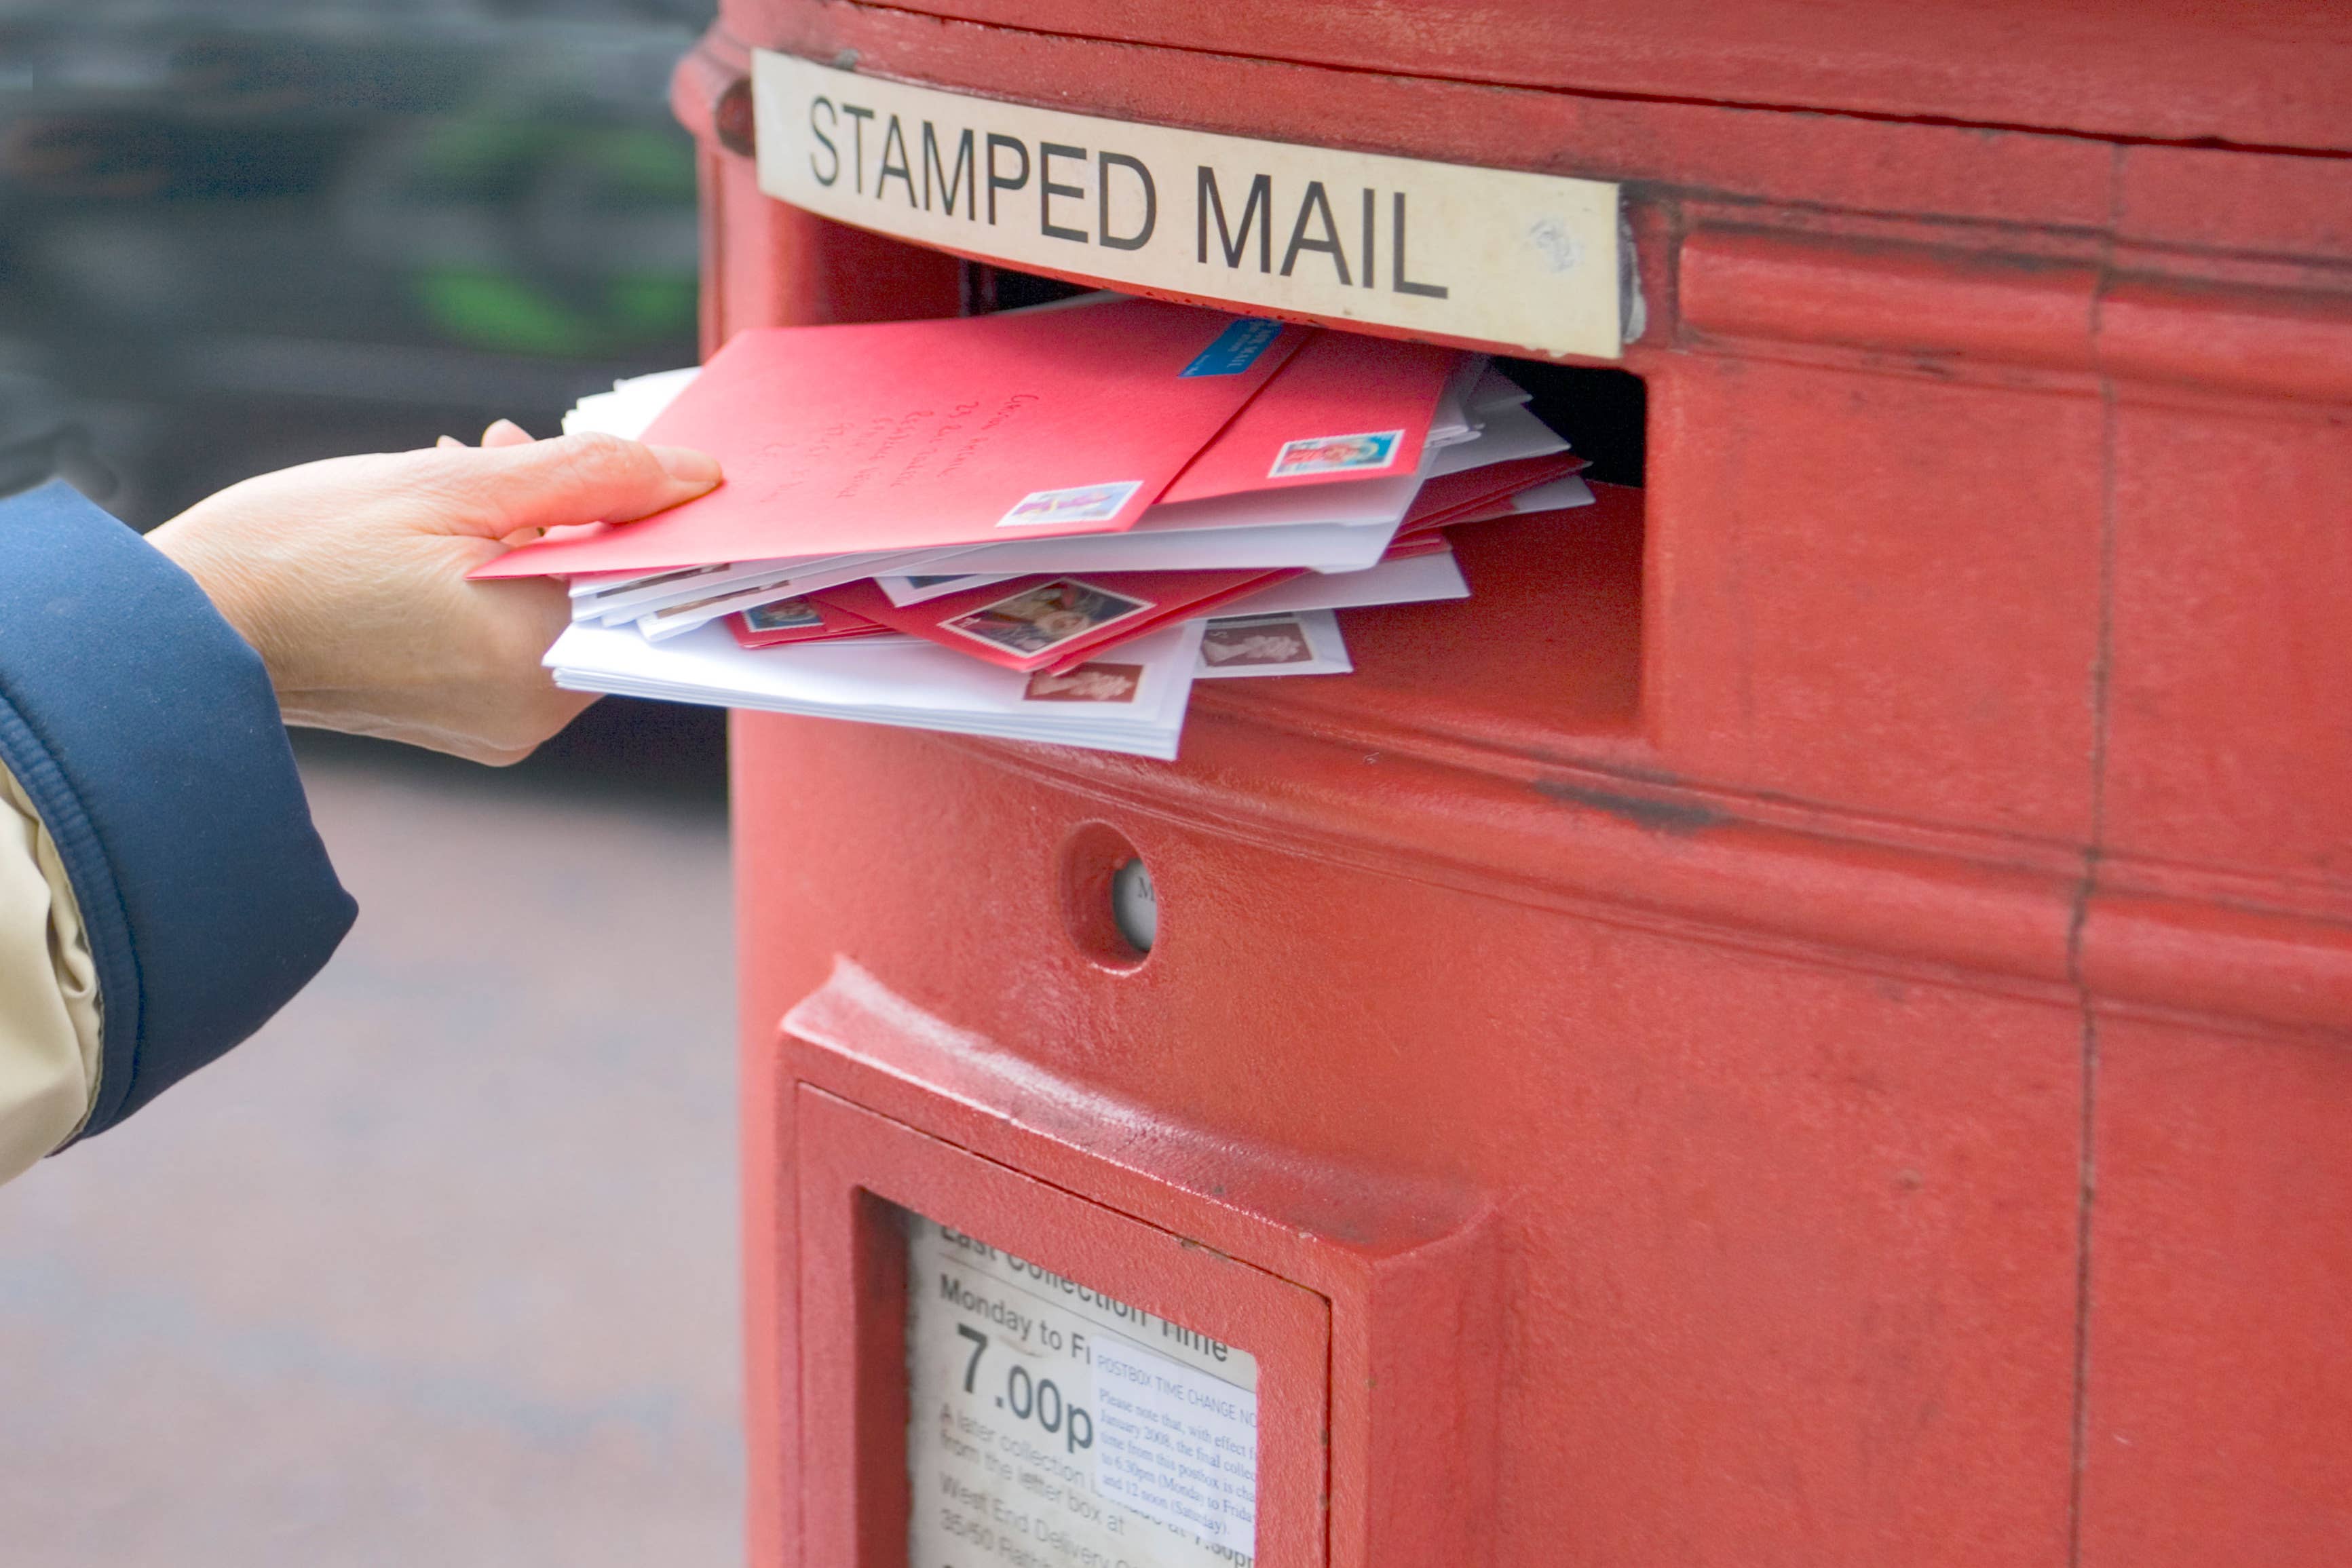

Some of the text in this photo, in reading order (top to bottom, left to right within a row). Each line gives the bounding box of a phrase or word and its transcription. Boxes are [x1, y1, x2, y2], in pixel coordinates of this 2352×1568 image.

[810, 95, 1449, 299] STAMPED MAIL
[940, 1272, 1032, 1341] Monday
[1040, 1320, 1063, 1350] to
[957, 1323, 1094, 1453] 7.00p
[1097, 1355, 1255, 1428] POSTBOX TIME CHANGE NO
[1099, 1388, 1133, 1413] Please
[1189, 1426, 1211, 1443] with
[1214, 1435, 1246, 1457] effect
[1100, 1409, 1140, 1439] January
[1176, 1440, 1194, 1457] the
[1196, 1447, 1221, 1468] final
[1224, 1461, 1255, 1483] collec
[1000, 1434, 1084, 1488] collection
[1126, 1480, 1139, 1497] 12
[1156, 1453, 1176, 1471] this
[1178, 1464, 1220, 1490] postbox
[1224, 1478, 1233, 1493] is
[1236, 1485, 1255, 1503] cha
[993, 1495, 1029, 1533] End
[1068, 1488, 1102, 1525] box
[1107, 1514, 1124, 1536] at
[1207, 1496, 1219, 1510] to
